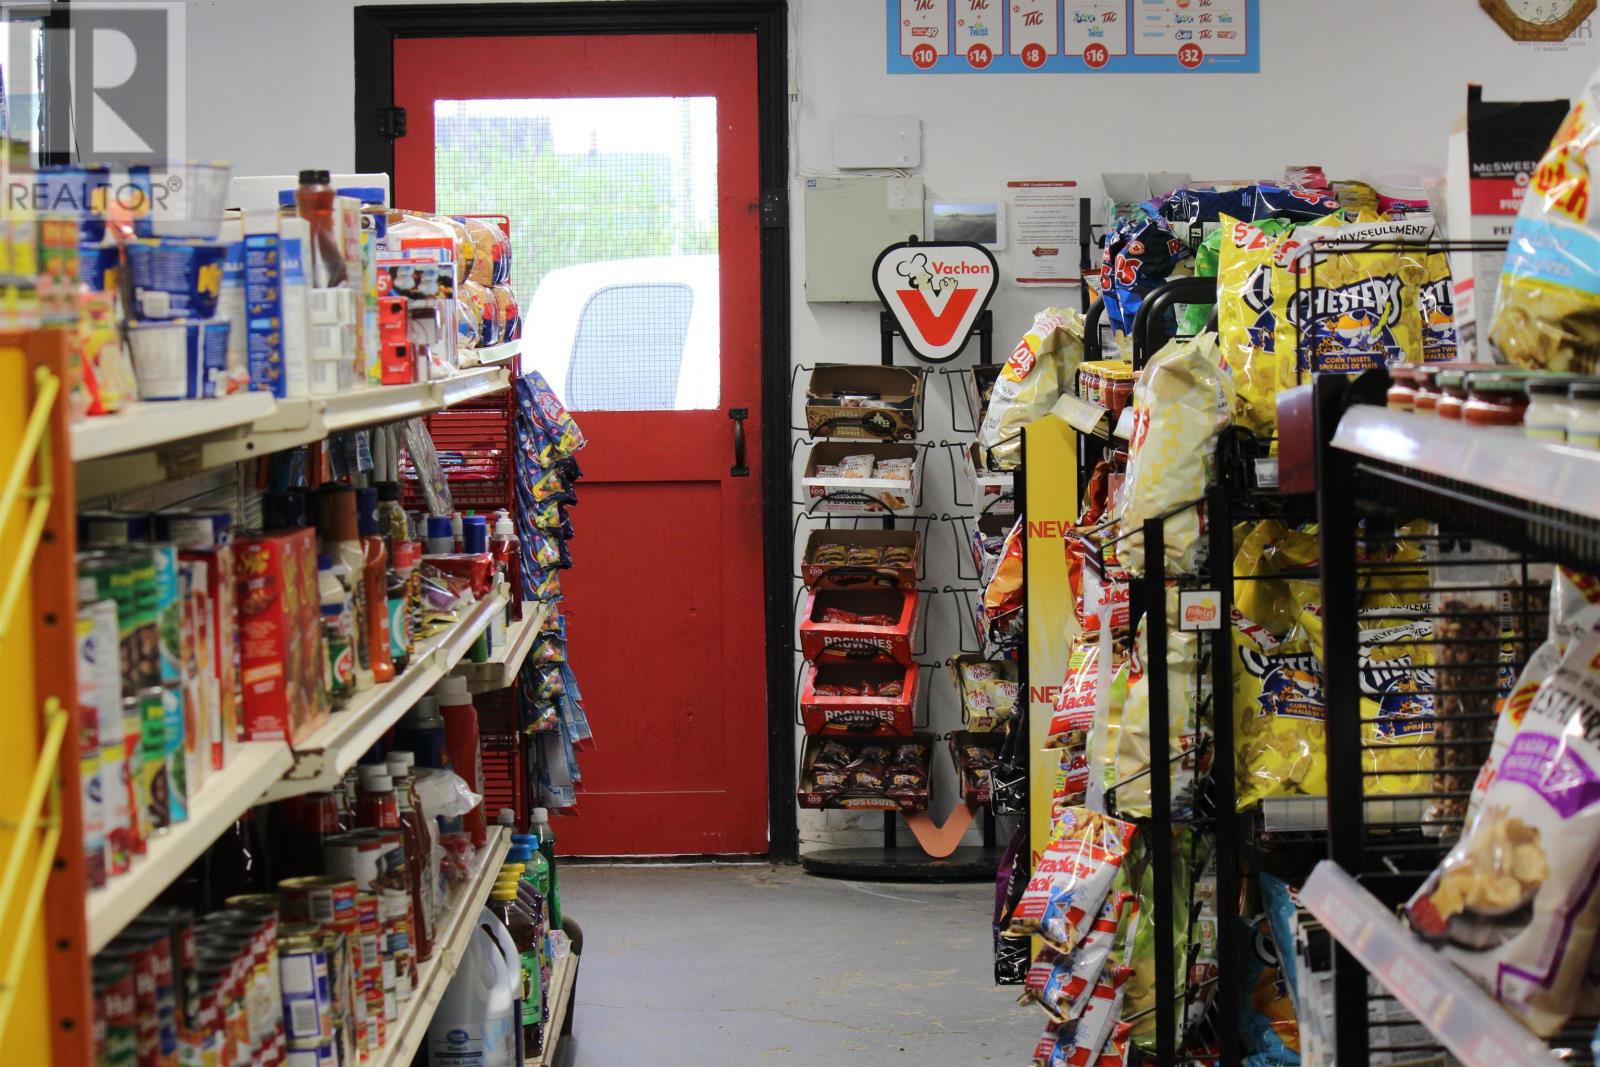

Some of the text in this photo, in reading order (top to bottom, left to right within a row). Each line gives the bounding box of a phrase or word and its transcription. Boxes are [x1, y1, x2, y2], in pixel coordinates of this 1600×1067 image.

[1522, 2, 1529, 11] 7
[1536, 6, 1543, 15] 6
[1551, 3, 1558, 12] 5
[1022, 11, 1044, 27] TAG
[1102, 11, 1117, 23] TAG
[1199, 13, 1212, 24] TAG
[1199, 29, 1212, 40] TAG
[914, 49, 933, 62] $10
[969, 49, 988, 62] $14
[1026, 49, 1040, 62] $8
[1086, 49, 1104, 62] $16
[1179, 49, 1199, 62] $32
[932, 261, 990, 275] Vachon
[1287, 274, 1402, 327] CHESTER'S
[1098, 588, 1130, 605] Jac
[1030, 686, 1064, 704] NE
[1038, 857, 1096, 879] racker
[1026, 876, 1054, 892] ack
